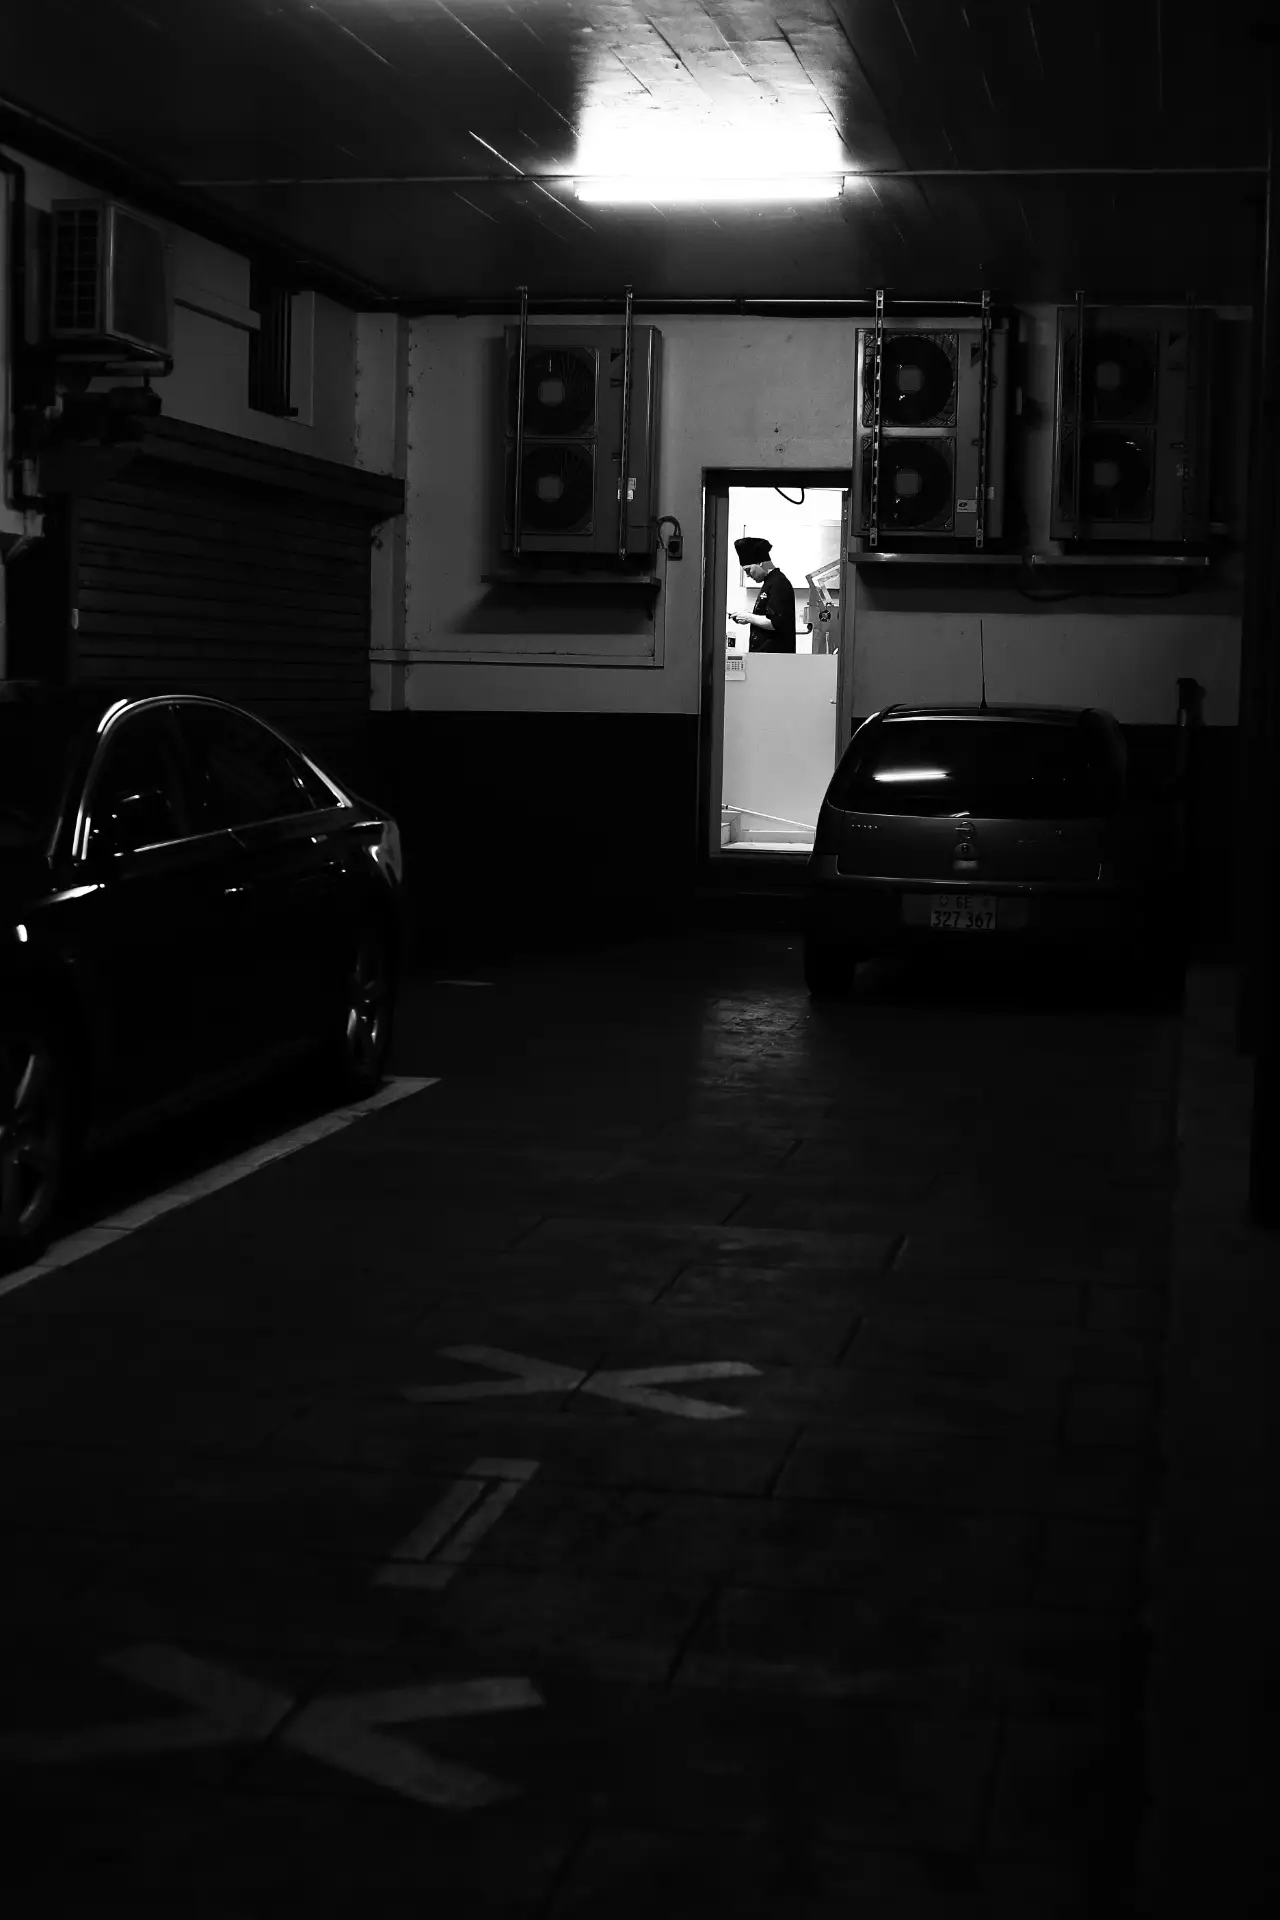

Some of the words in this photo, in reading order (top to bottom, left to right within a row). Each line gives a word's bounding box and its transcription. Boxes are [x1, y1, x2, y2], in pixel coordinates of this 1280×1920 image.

[956, 896, 972, 908] GE
[933, 911, 960, 928] 327
[965, 912, 992, 928] 367
